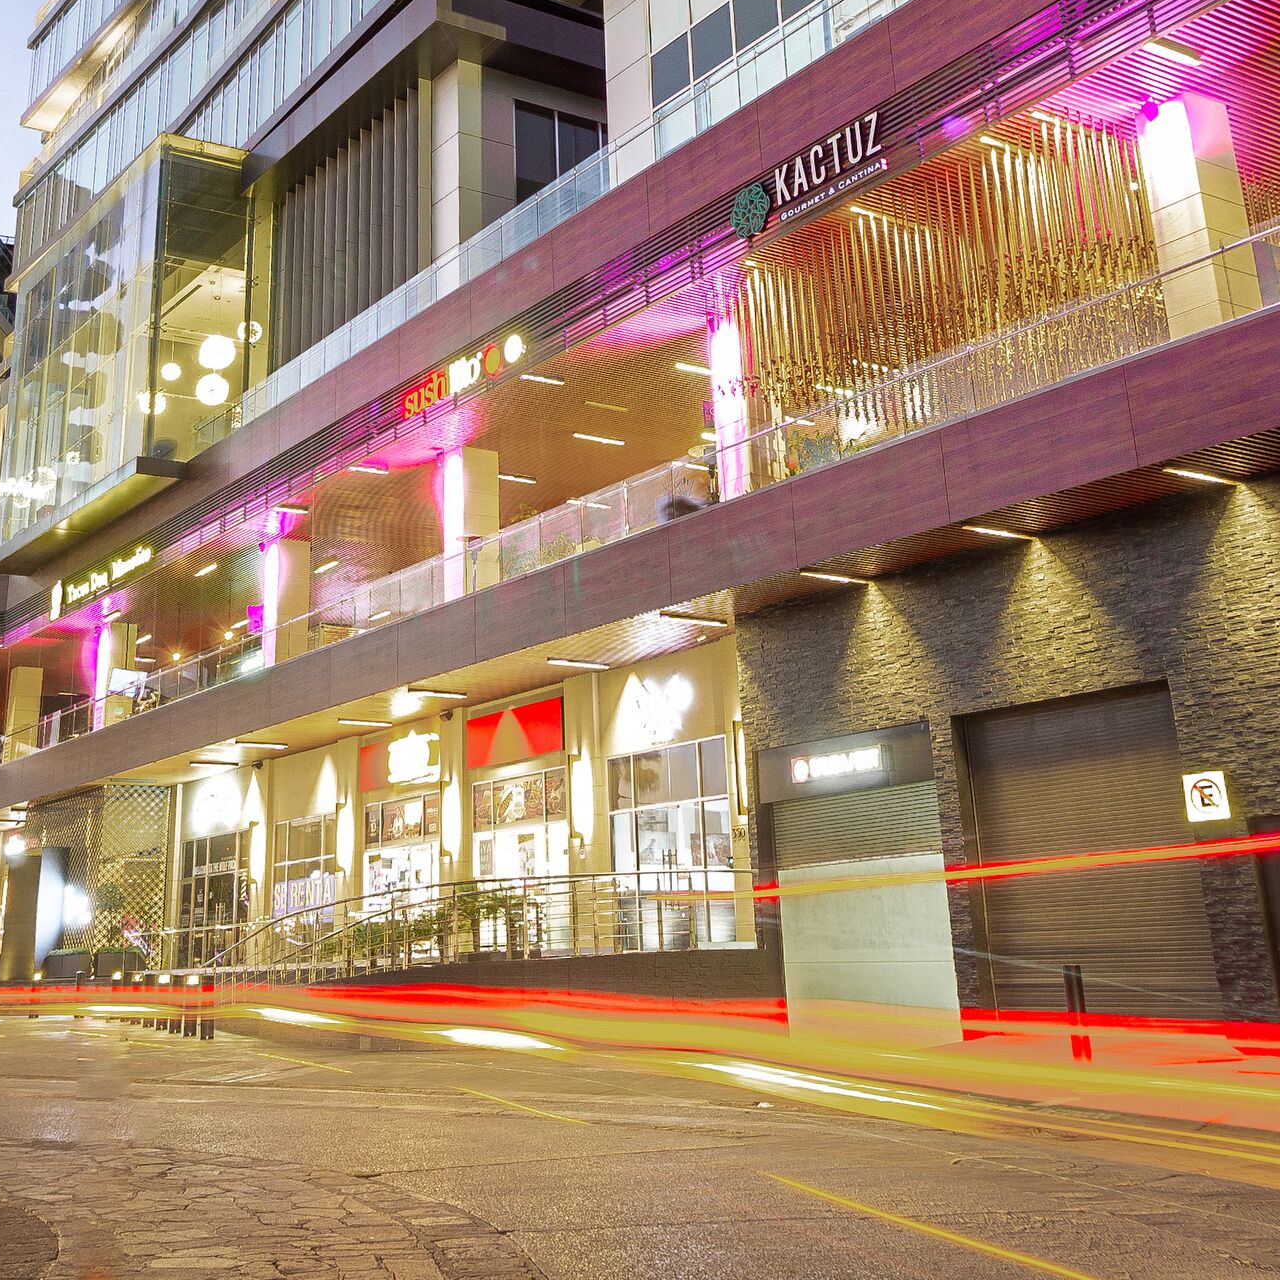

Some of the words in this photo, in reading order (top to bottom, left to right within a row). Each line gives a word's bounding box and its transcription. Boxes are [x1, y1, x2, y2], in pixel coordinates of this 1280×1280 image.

[774, 111, 882, 206] KACTUZ
[780, 190, 826, 221] GOURMET
[828, 186, 836, 195] &
[838, 162, 882, 190] CANTINA
[289, 878, 332, 908] RENTA
